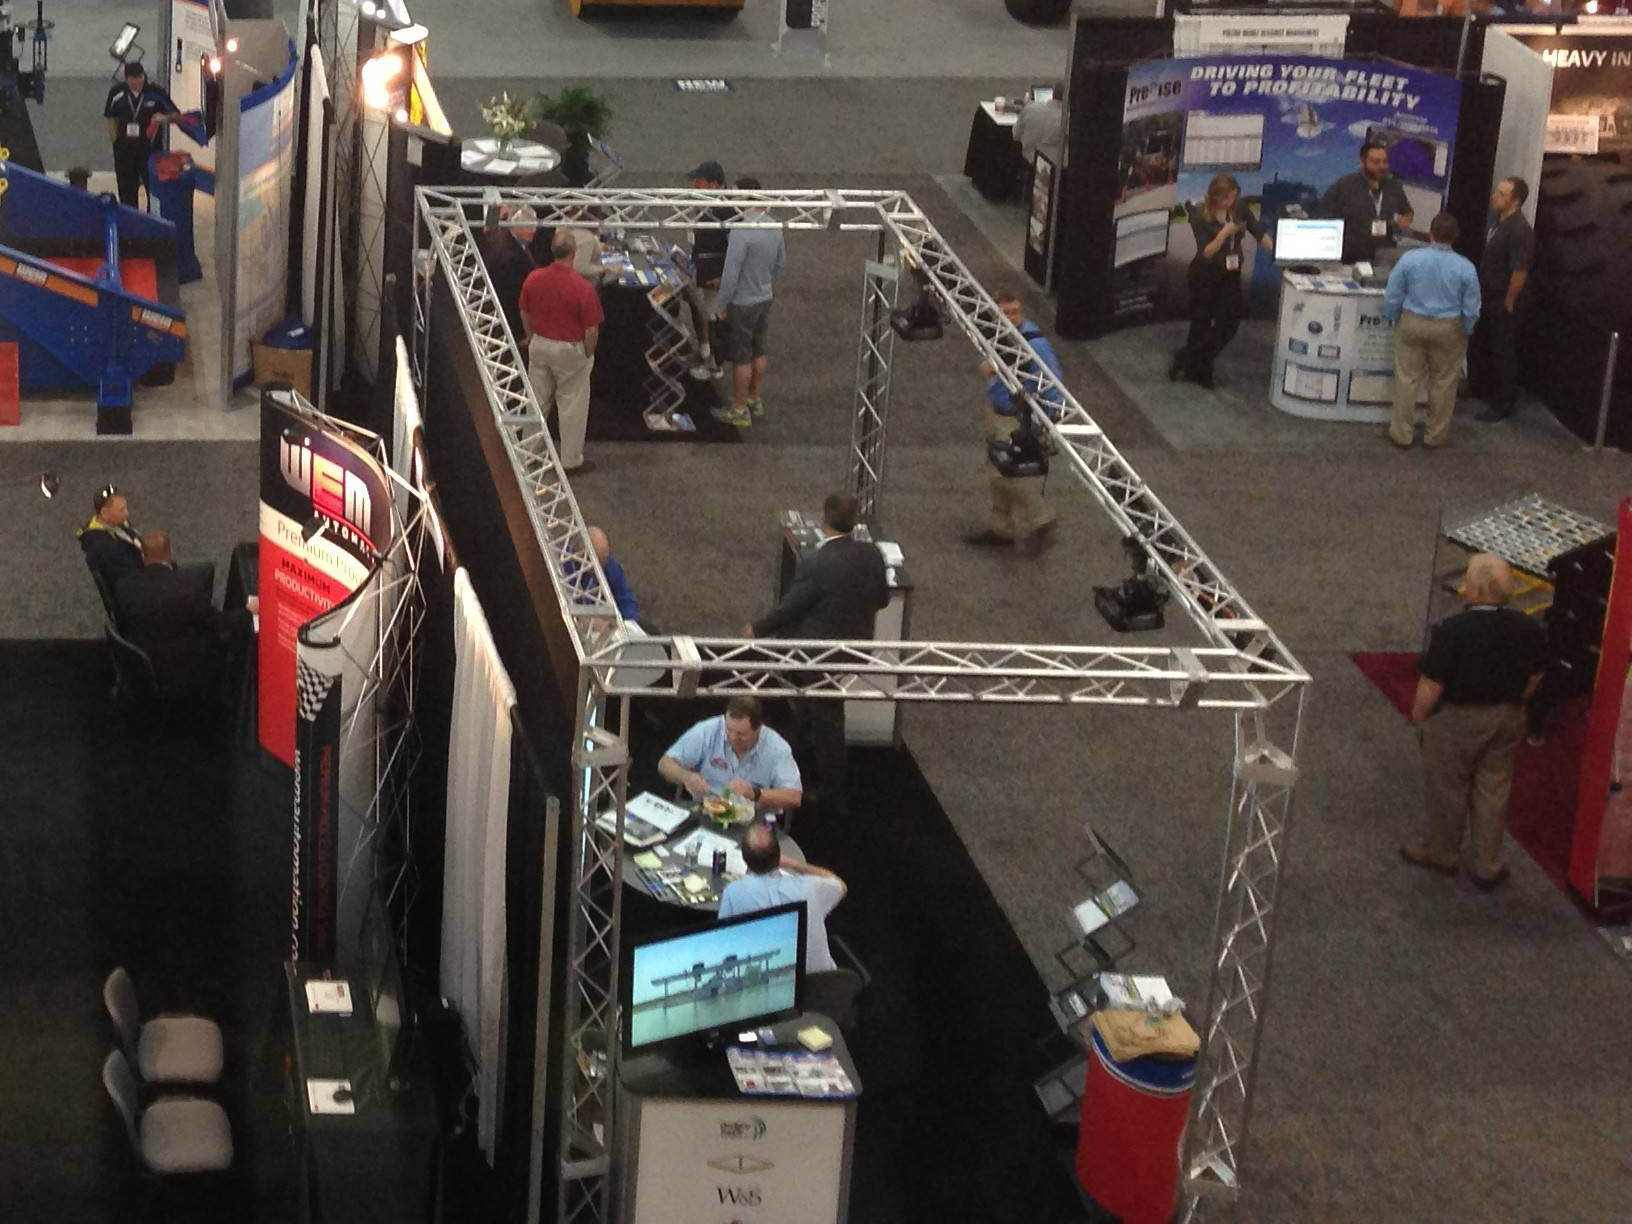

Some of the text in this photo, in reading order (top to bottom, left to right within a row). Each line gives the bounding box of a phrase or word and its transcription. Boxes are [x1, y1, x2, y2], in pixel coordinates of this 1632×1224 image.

[1542, 49, 1608, 68] HEAVY
[1190, 64, 1410, 90] DRIVING YOUR FLEET
[1209, 80, 1421, 112] TO PROFITABILITY
[281, 557, 332, 594] MAXIMUM
